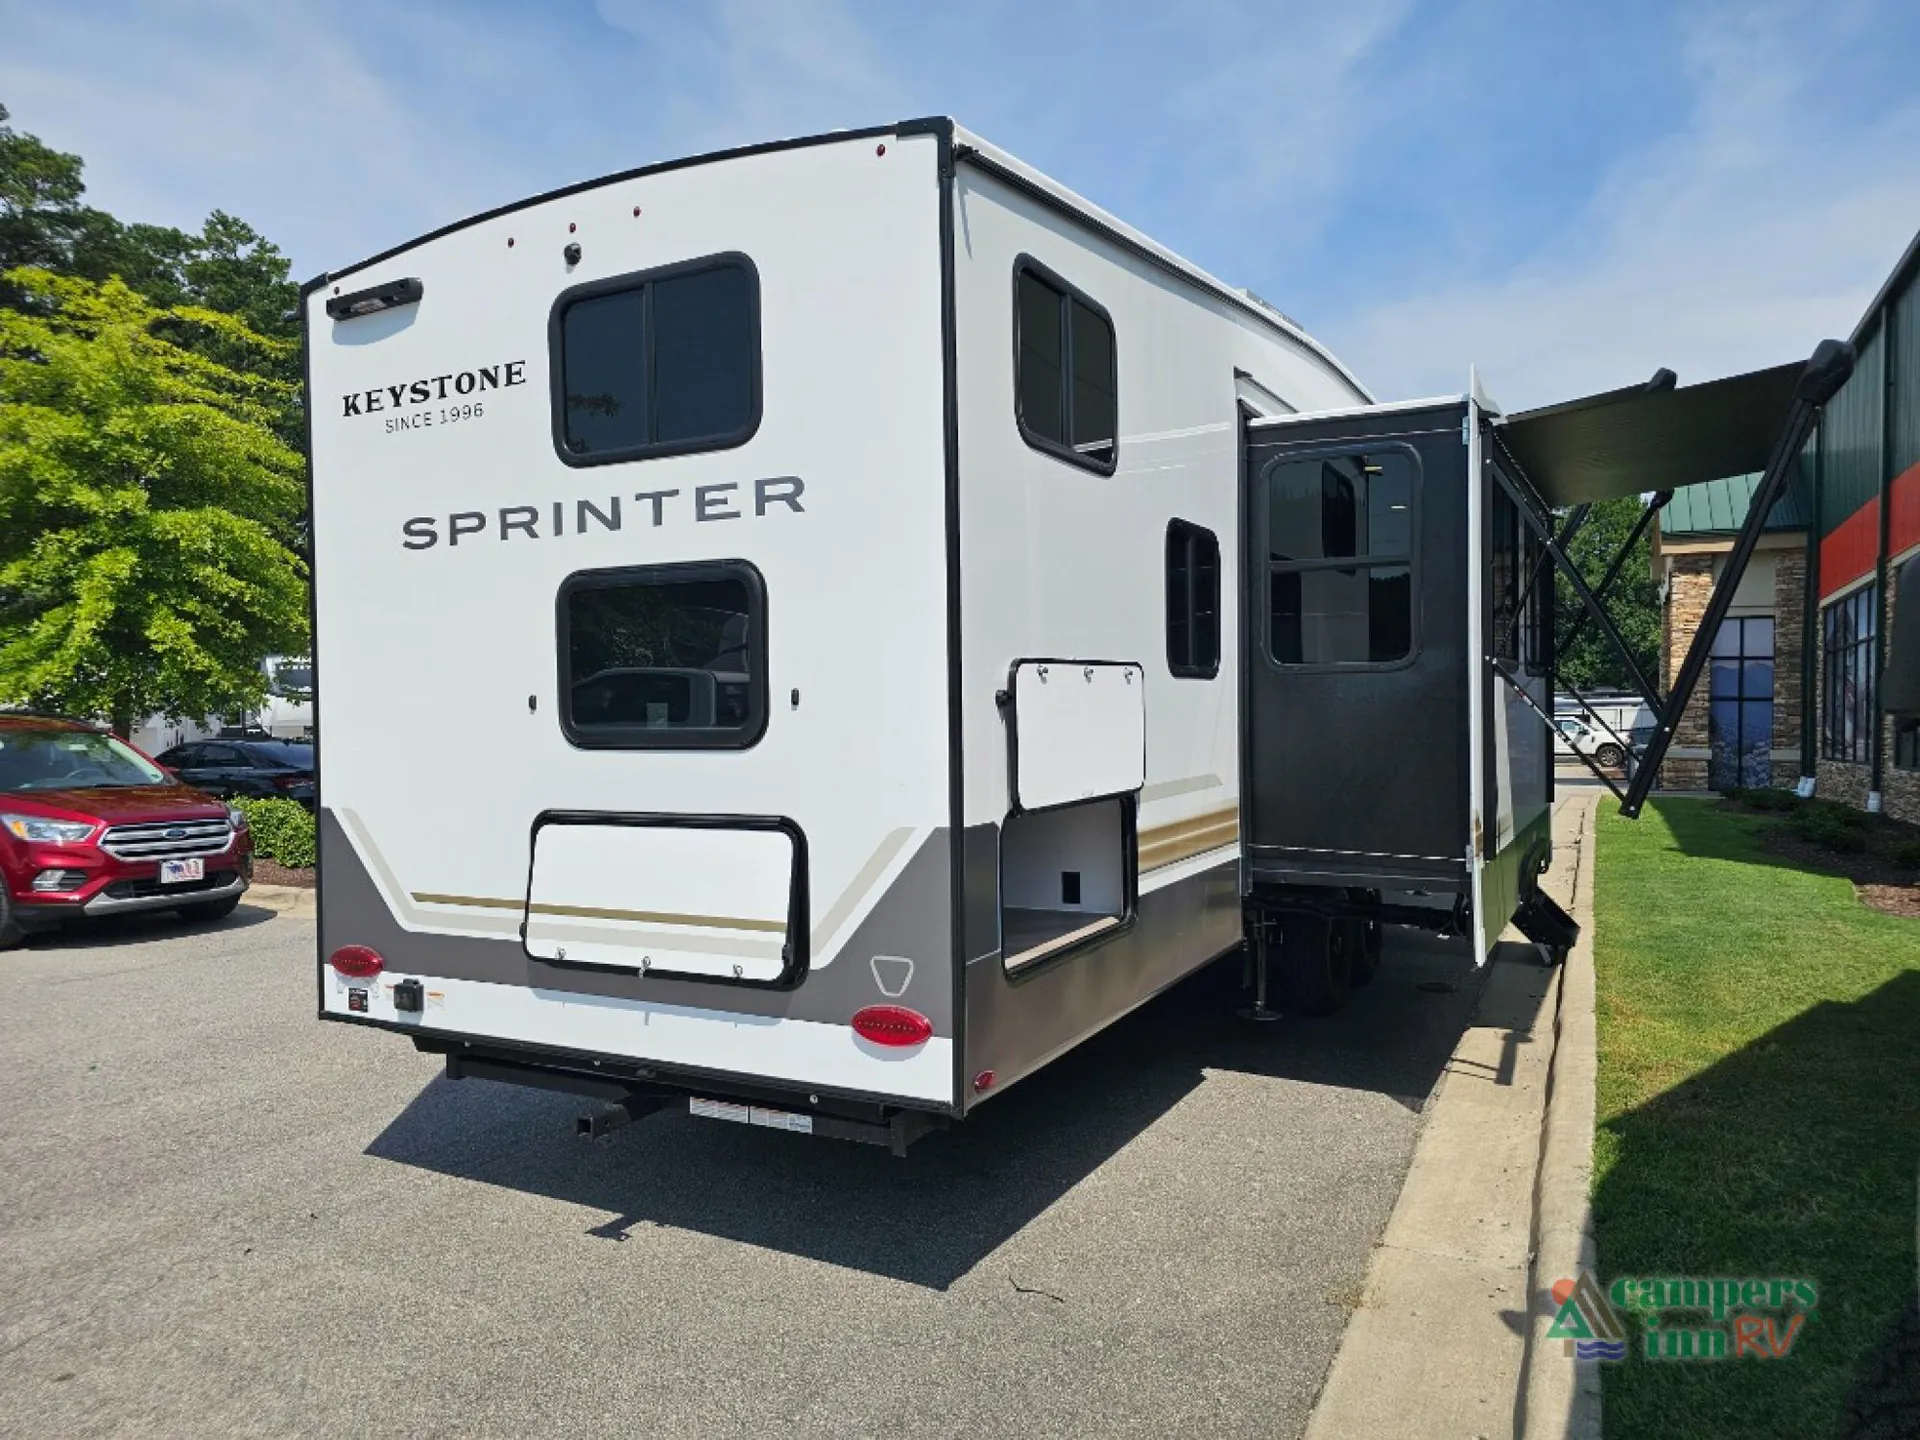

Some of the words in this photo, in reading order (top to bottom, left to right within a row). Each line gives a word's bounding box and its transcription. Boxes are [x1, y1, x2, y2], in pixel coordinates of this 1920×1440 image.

[342, 360, 527, 417] KEYSTONE
[385, 411, 433, 434] SINCE
[439, 402, 484, 425] 1996
[402, 475, 806, 551] SPRINTER
